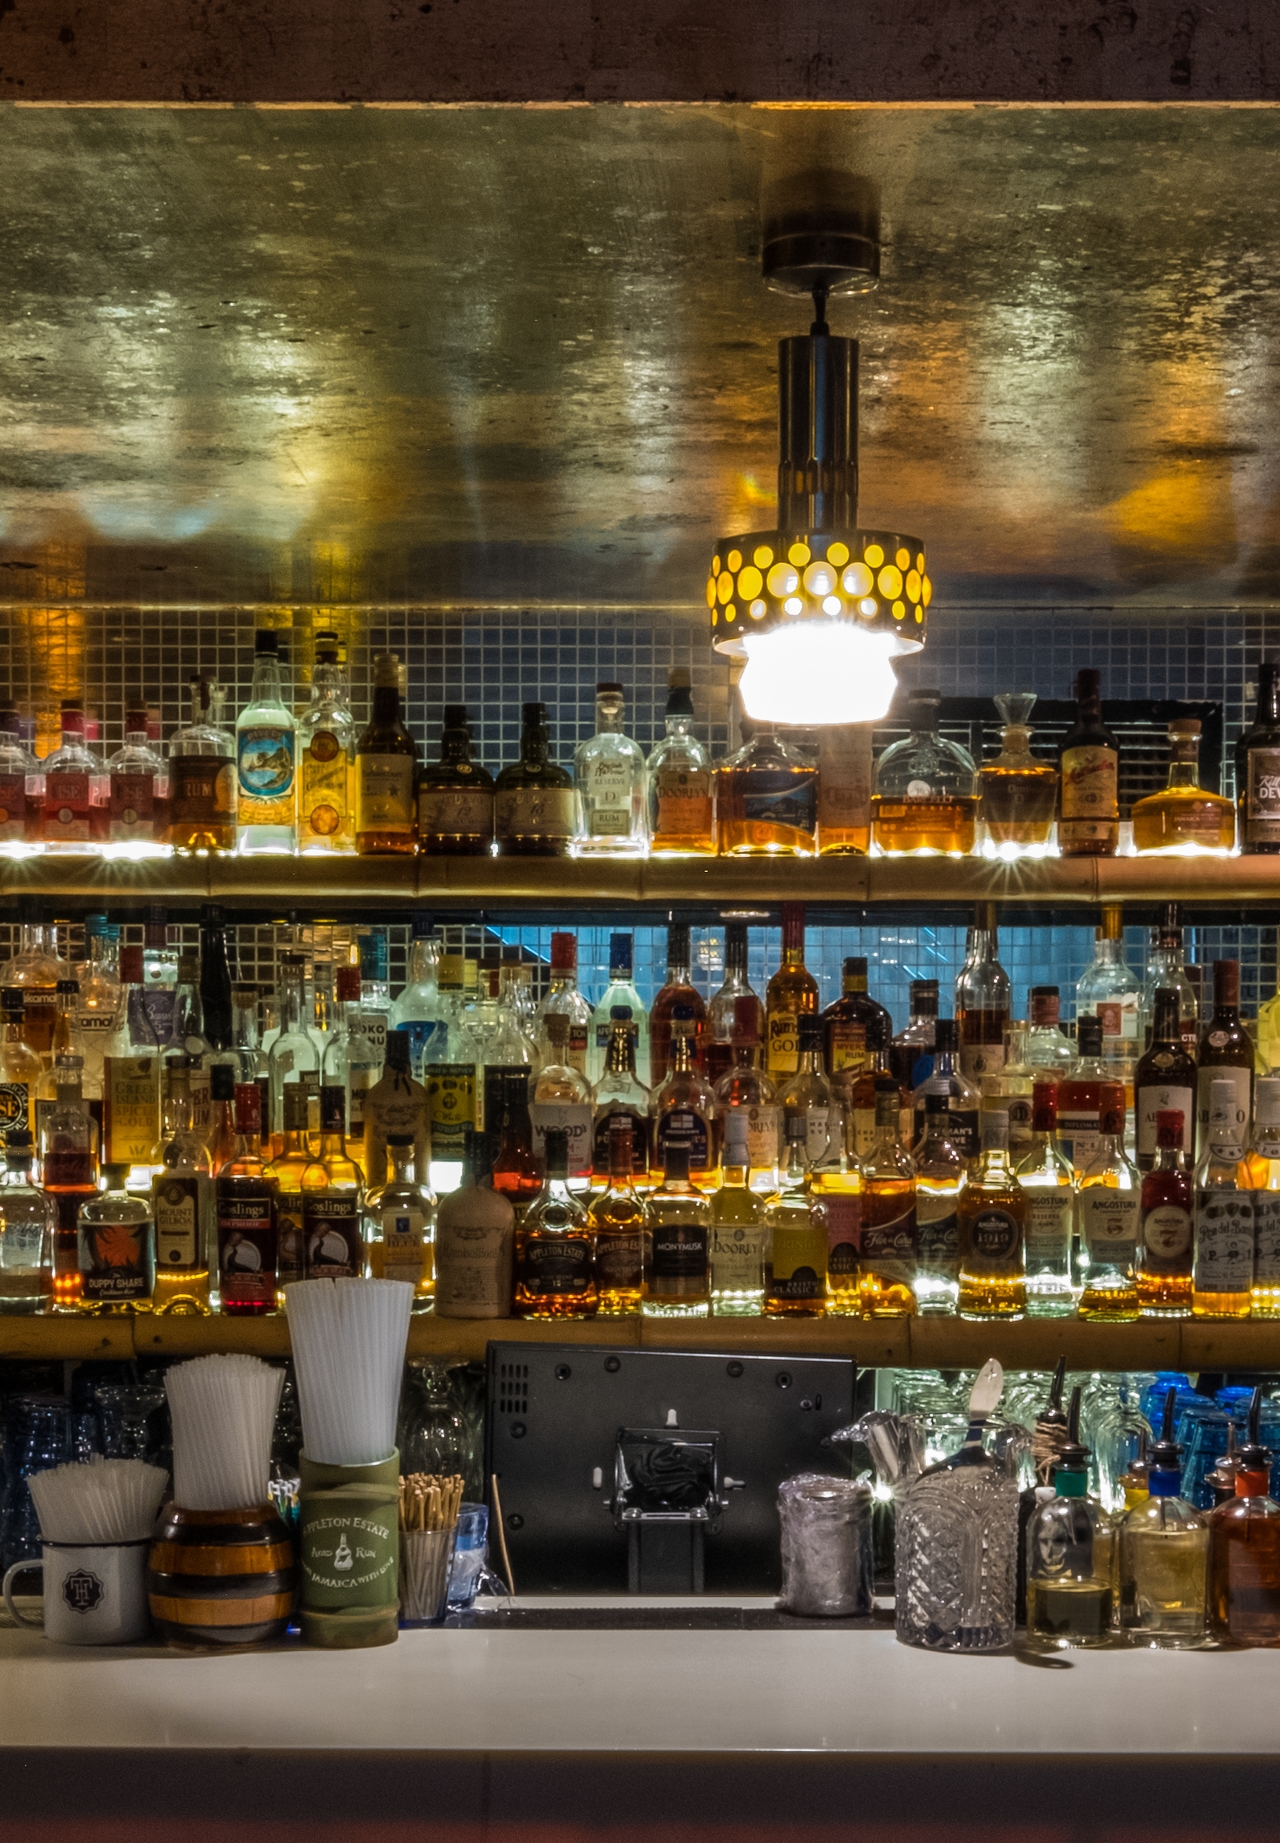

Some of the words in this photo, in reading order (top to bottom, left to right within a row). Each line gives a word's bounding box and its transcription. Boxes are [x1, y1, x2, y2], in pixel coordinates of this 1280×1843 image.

[598, 814, 620, 823] RUM
[845, 1051, 866, 1060] RUM
[115, 1094, 157, 1105] ISLAND
[115, 1105, 157, 1117] SPICED
[116, 1115, 153, 1127] GOLD
[1026, 1196, 1069, 1206] NGOSTURA
[1092, 1200, 1137, 1210] ANGOSTURA
[158, 1208, 192, 1217] MOUNT
[158, 1216, 192, 1225] GILBOA
[977, 1232, 1010, 1244] 1919
[1159, 1228, 1178, 1248] 7
[656, 1242, 703, 1251] MONYMUSK
[529, 1246, 563, 1262] APPLETON
[563, 1245, 585, 1261] ESTATE
[88, 1278, 115, 1289] DUPPY
[116, 1277, 145, 1288] SHARE
[773, 1286, 814, 1294] CLASSIC
[303, 1517, 351, 1536] APPLETON
[352, 1517, 390, 1540] ESTATE
[311, 1573, 359, 1588] JAMAICA
